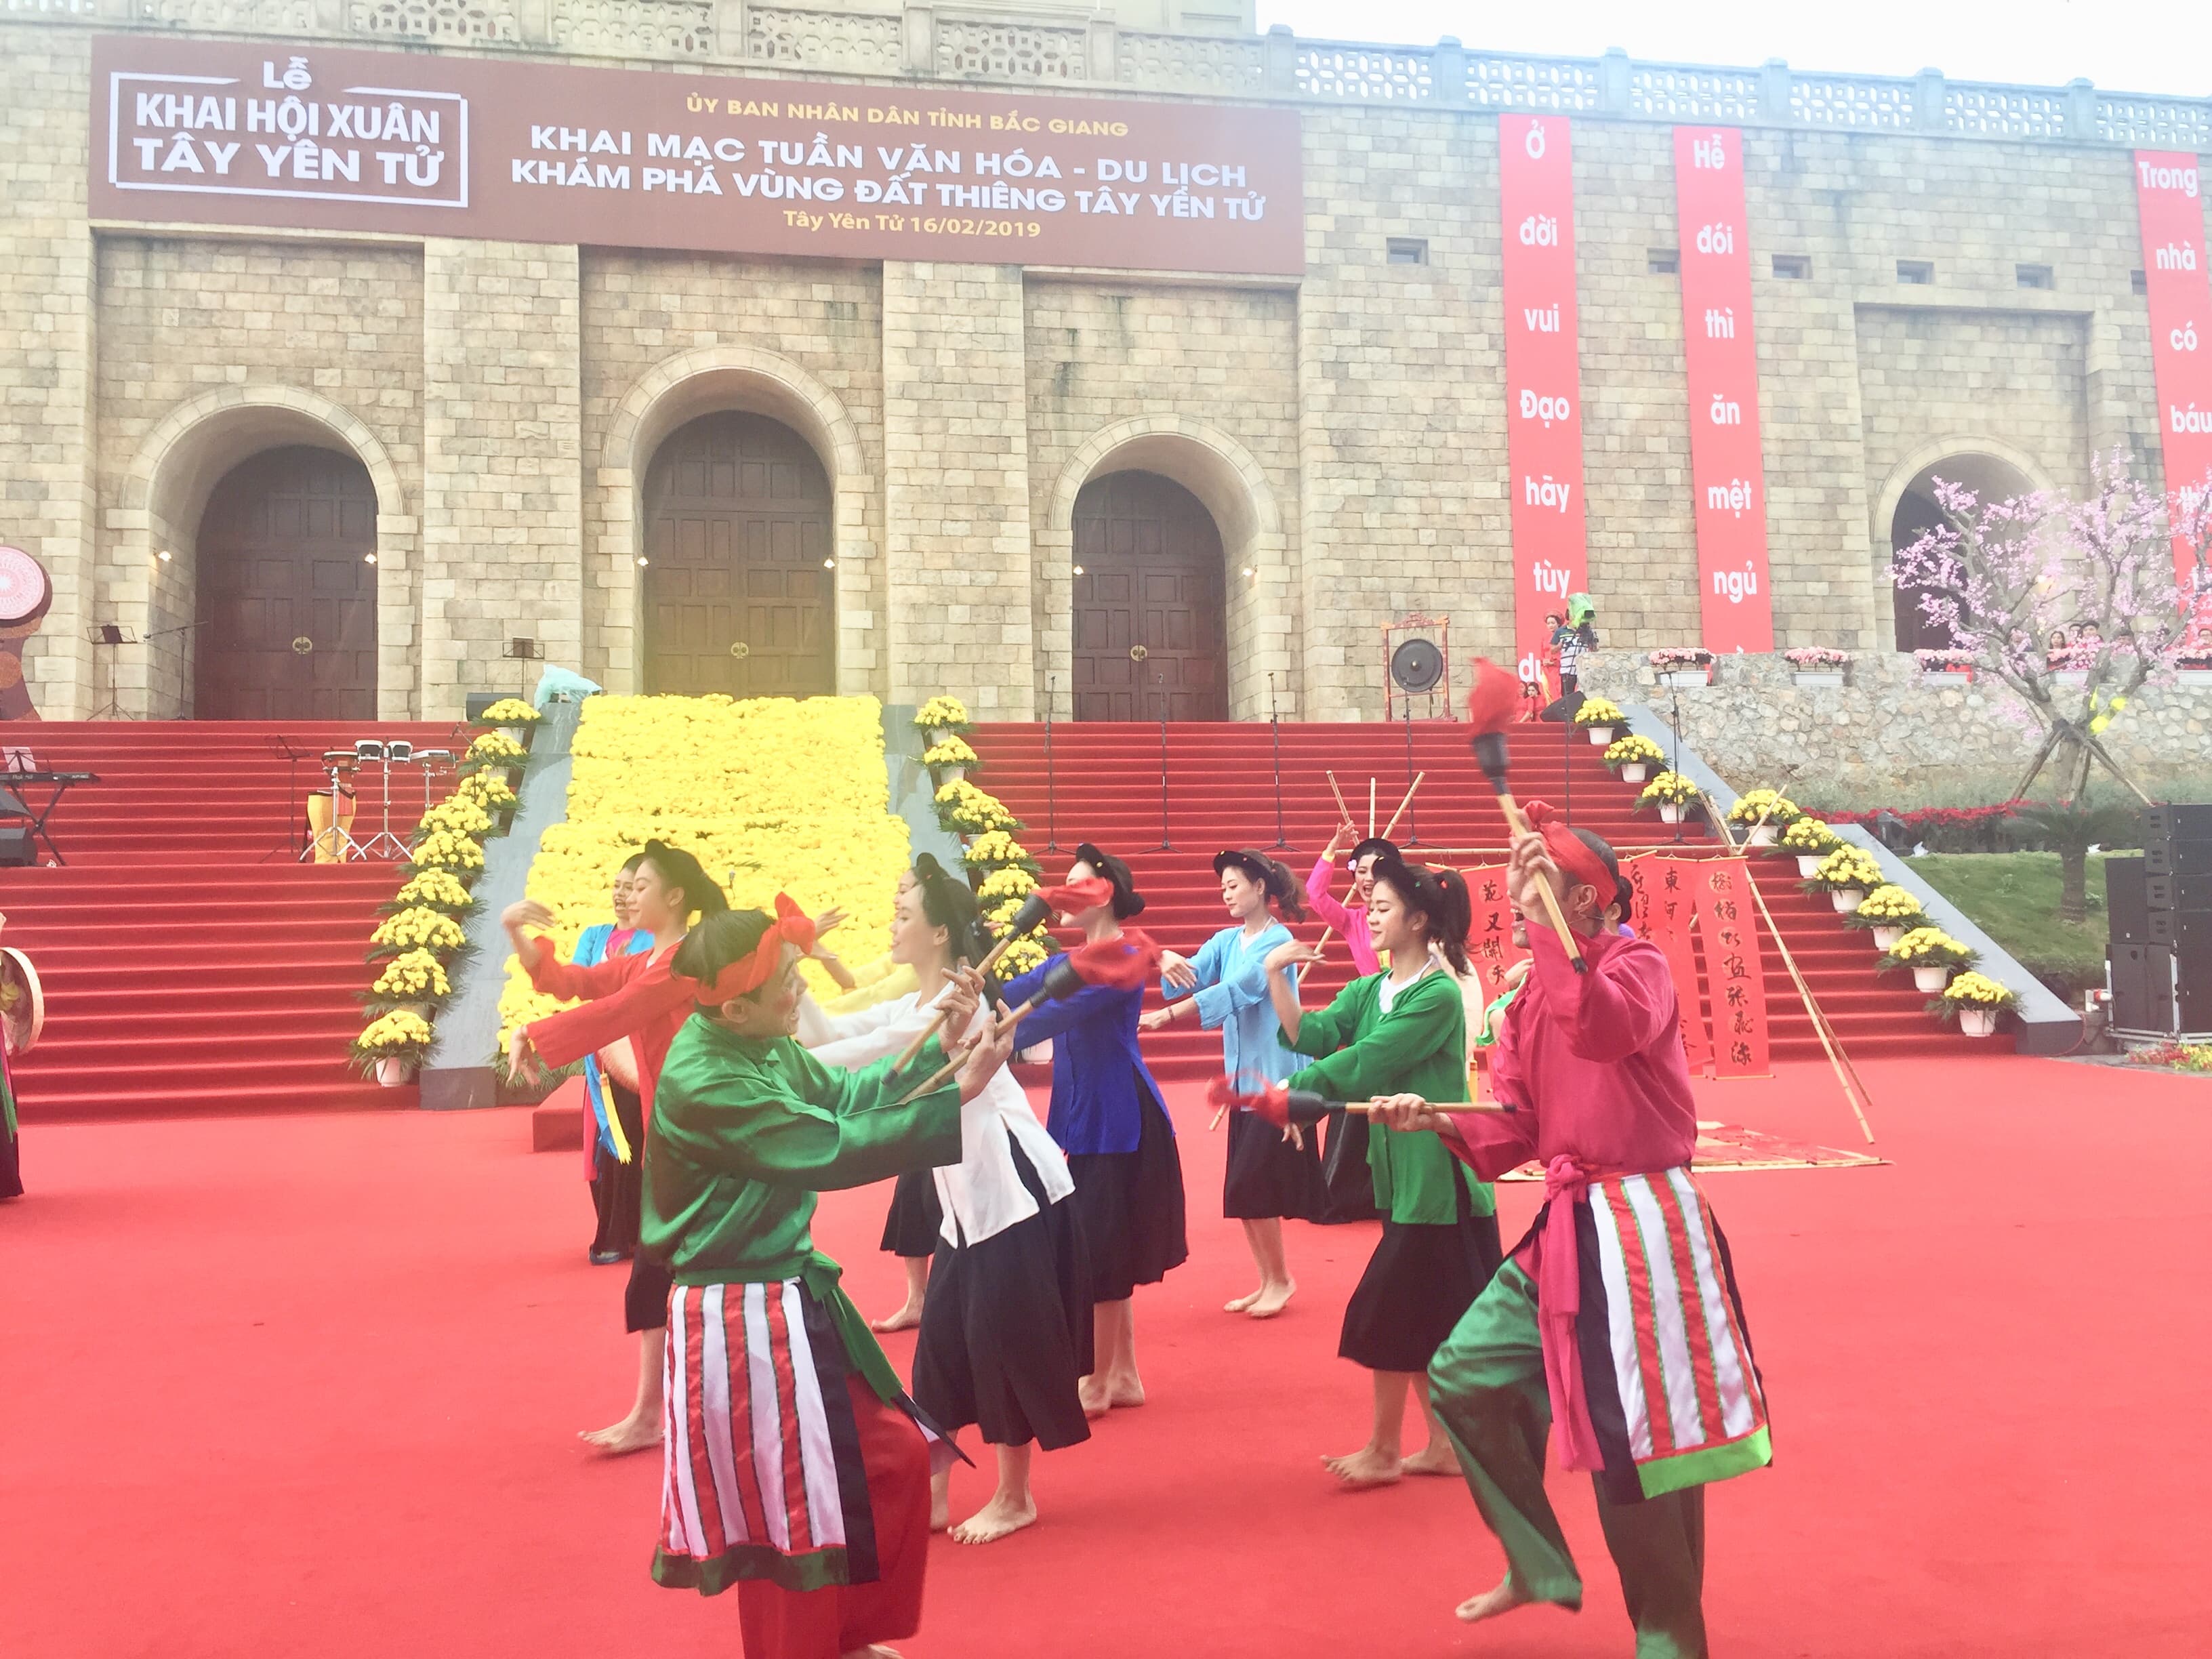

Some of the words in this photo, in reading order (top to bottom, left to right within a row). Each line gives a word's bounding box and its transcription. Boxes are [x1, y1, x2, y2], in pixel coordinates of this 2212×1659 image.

[263, 56, 312, 91] Lễ
[136, 92, 235, 131] KHAI
[247, 95, 319, 142] HỘI
[328, 102, 439, 144] XUÂN
[687, 92, 718, 114] ỦY
[728, 99, 778, 117] BAN
[788, 102, 859, 123] NHÂN
[867, 105, 920, 125] DÂN
[928, 108, 981, 129] TỈNH
[990, 110, 1040, 132] BẮC
[1048, 118, 1128, 137] GIANG
[1525, 119, 1545, 159] Ở
[1694, 134, 1725, 169] Hễ
[133, 133, 240, 174] TÂY
[253, 140, 359, 182] YÊN
[376, 144, 445, 186] TỬ
[531, 125, 631, 155] KHAI
[648, 133, 745, 167] MẠC
[758, 131, 863, 169] TUẦN
[877, 143, 960, 173] VĂN
[976, 147, 1063, 179] HÓA
[1098, 159, 1147, 182] DU
[1163, 162, 1246, 190] LỊCH
[512, 157, 630, 189] KHÁM
[642, 165, 722, 195] PHÁ
[733, 168, 844, 201] VÙNG
[855, 171, 927, 205] ĐẤT
[936, 181, 1066, 212] THIÊNG
[1075, 186, 1141, 215] TÂY
[1149, 190, 1214, 219] YÊN
[1223, 190, 1267, 221] TỬ
[2139, 161, 2198, 197] Trong
[783, 210, 823, 231] Tây
[828, 212, 869, 229] Yên
[876, 213, 904, 232] Tử
[910, 217, 1041, 237] 16/02/2019
[1519, 213, 1558, 247] đời
[1696, 222, 1733, 254] đói
[2156, 241, 2196, 271] nhà
[1524, 304, 1559, 332] vui
[1705, 307, 1735, 338] thì
[2170, 321, 2198, 352] có
[1520, 390, 1570, 428] Đạo
[1711, 393, 1740, 425] ăn
[2171, 402, 2211, 433] báu
[1525, 475, 1570, 513] hãy
[1708, 478, 1752, 518] mệt
[1533, 559, 1570, 599] tùy
[1713, 560, 1757, 604] ngủ
